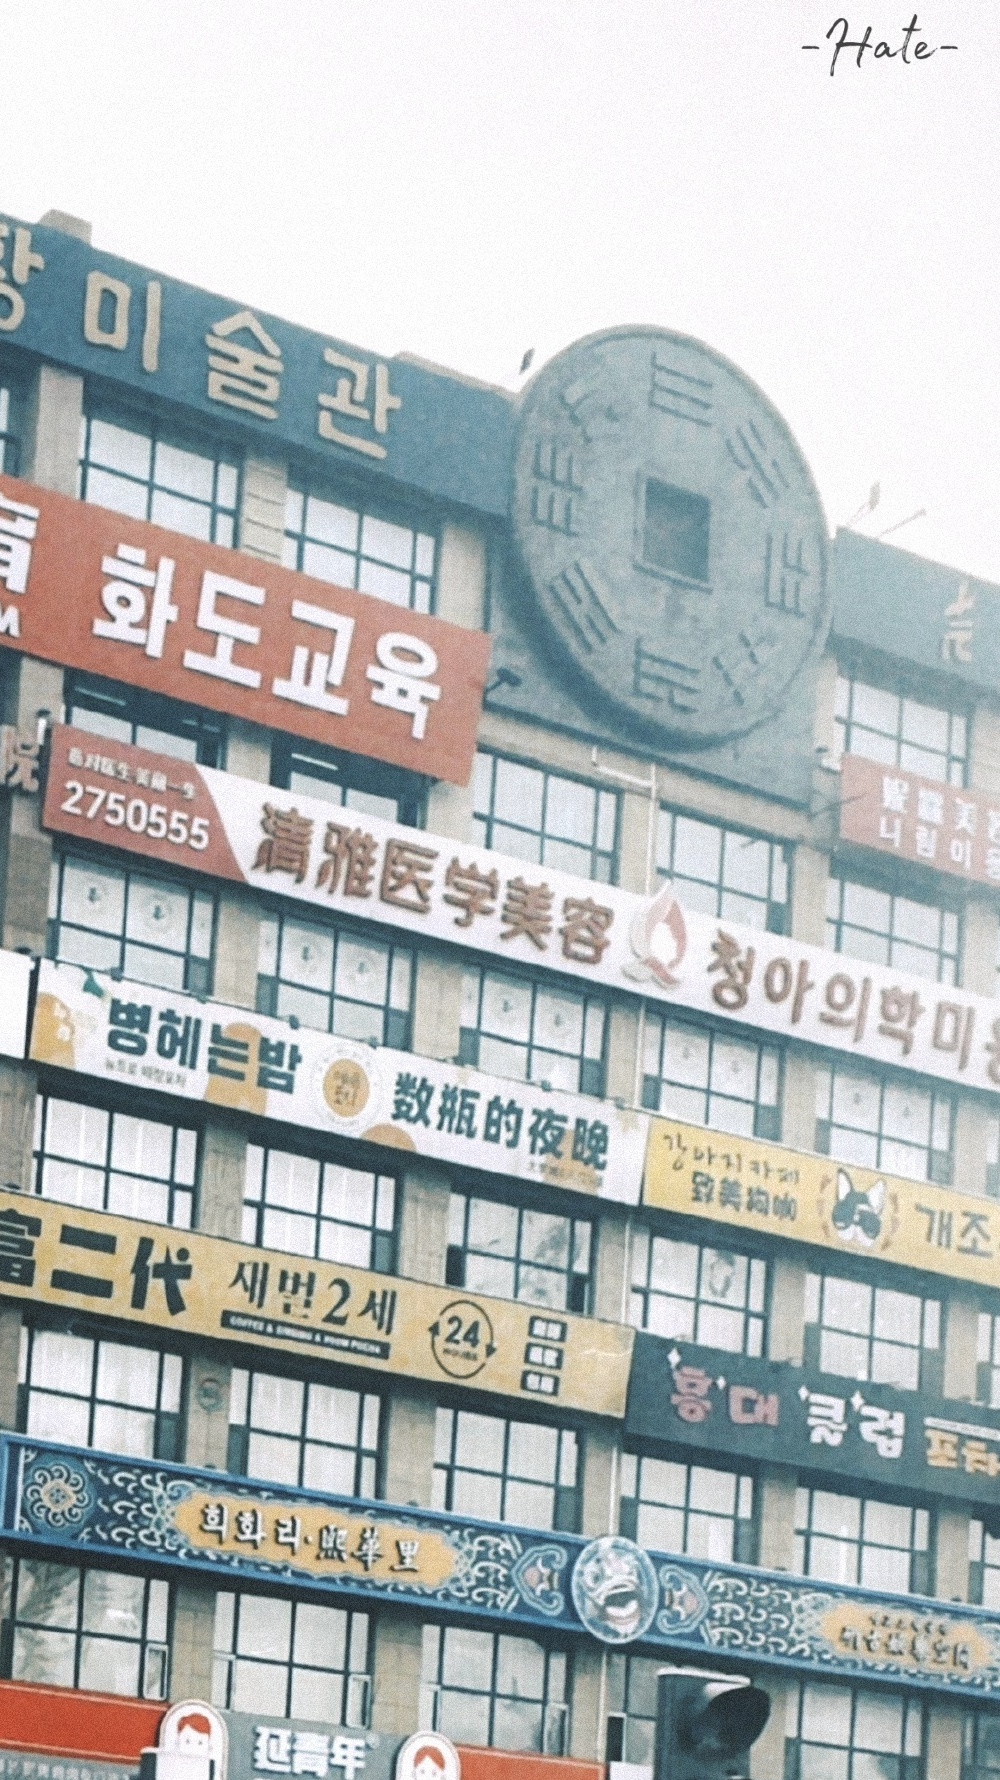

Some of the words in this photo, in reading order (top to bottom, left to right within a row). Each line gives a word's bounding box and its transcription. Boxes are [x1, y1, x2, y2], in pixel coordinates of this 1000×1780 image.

[91, 545, 442, 740] 화도교육
[60, 780, 210, 850] 2750555
[391, 1073, 609, 1170] 数瓶的夜晚
[914, 1203, 1000, 1260] 개조
[446, 1315, 481, 1348] 24
[254, 1726, 367, 1780] 延青年
